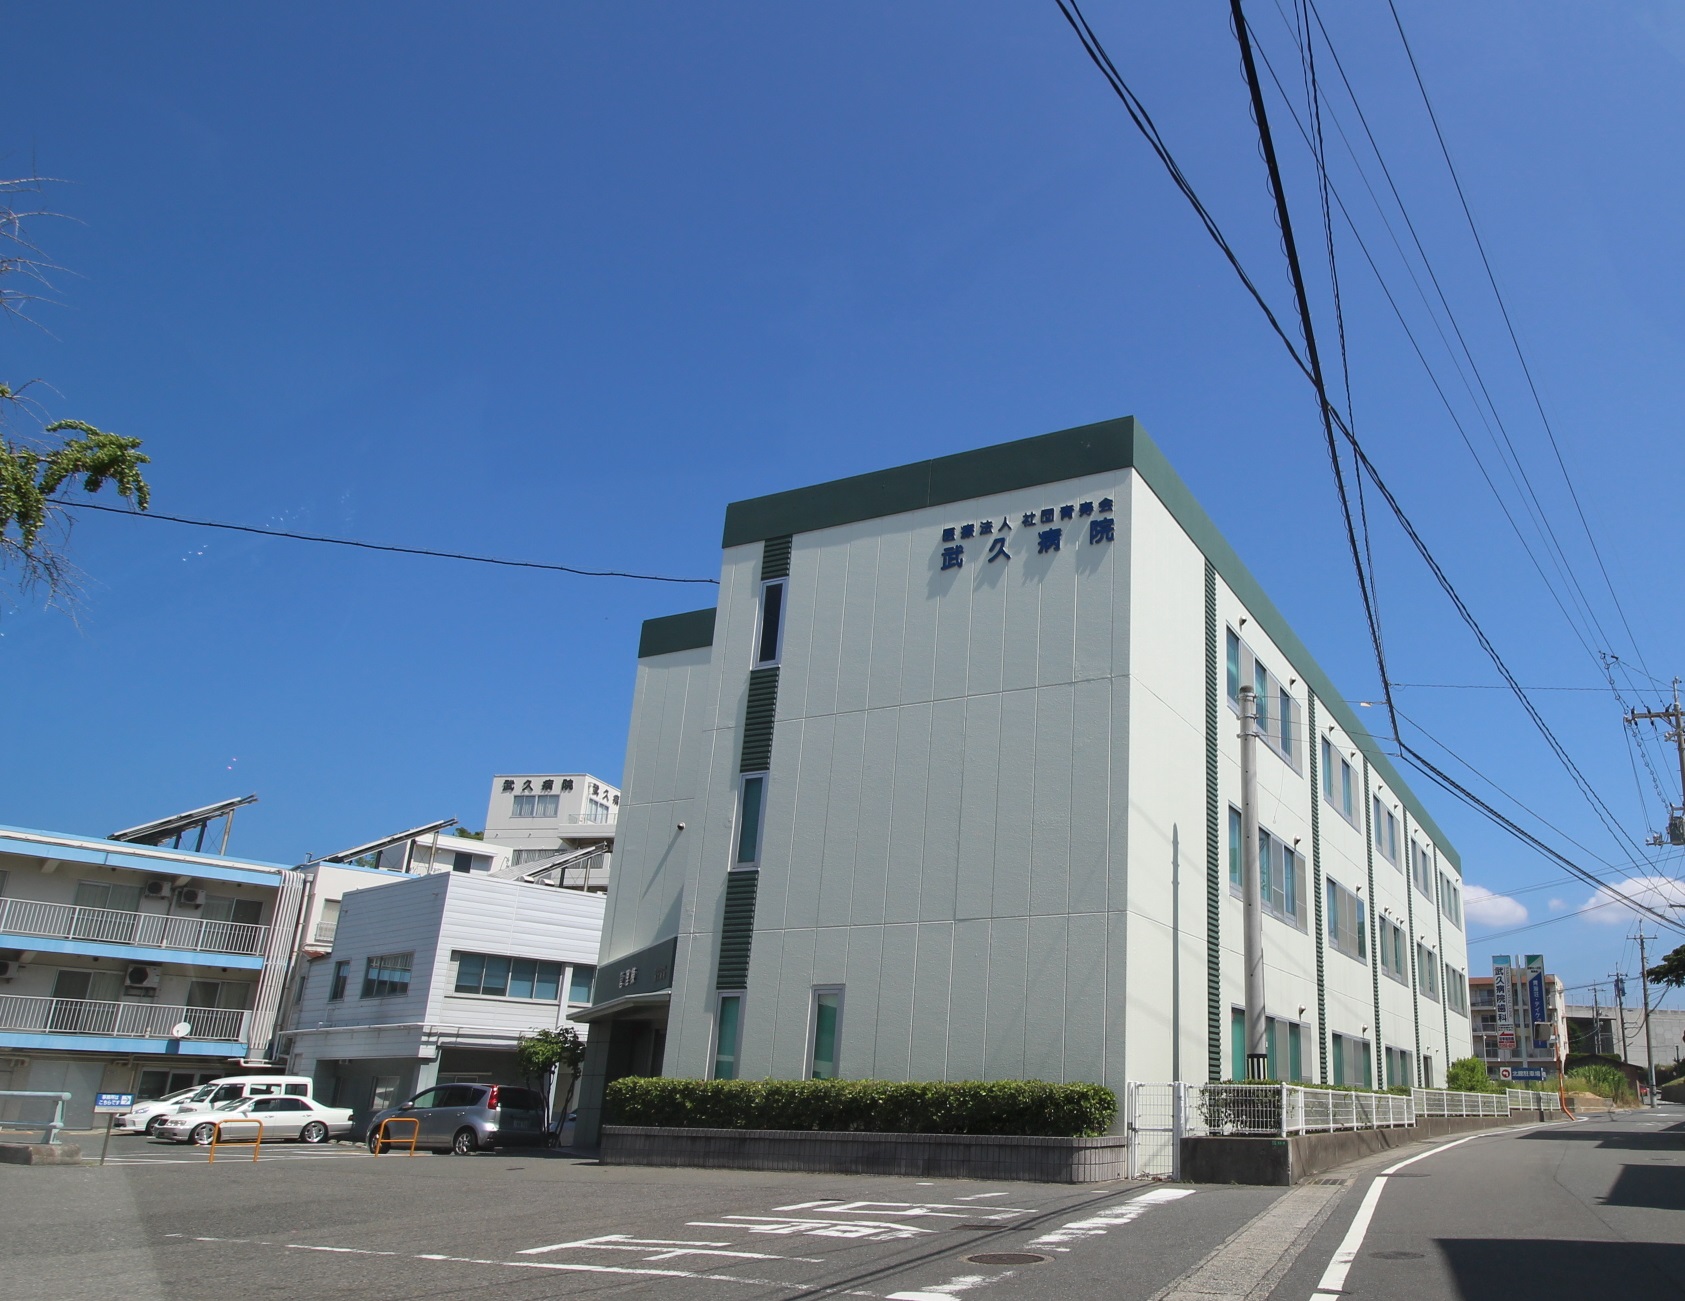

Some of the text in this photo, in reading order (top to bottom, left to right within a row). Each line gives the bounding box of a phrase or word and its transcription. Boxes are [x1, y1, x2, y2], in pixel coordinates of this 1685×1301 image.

[940, 516, 1116, 571] 武久病院
[502, 778, 574, 793] 武久病院
[1494, 966, 1507, 1023] 武久病院歯科
